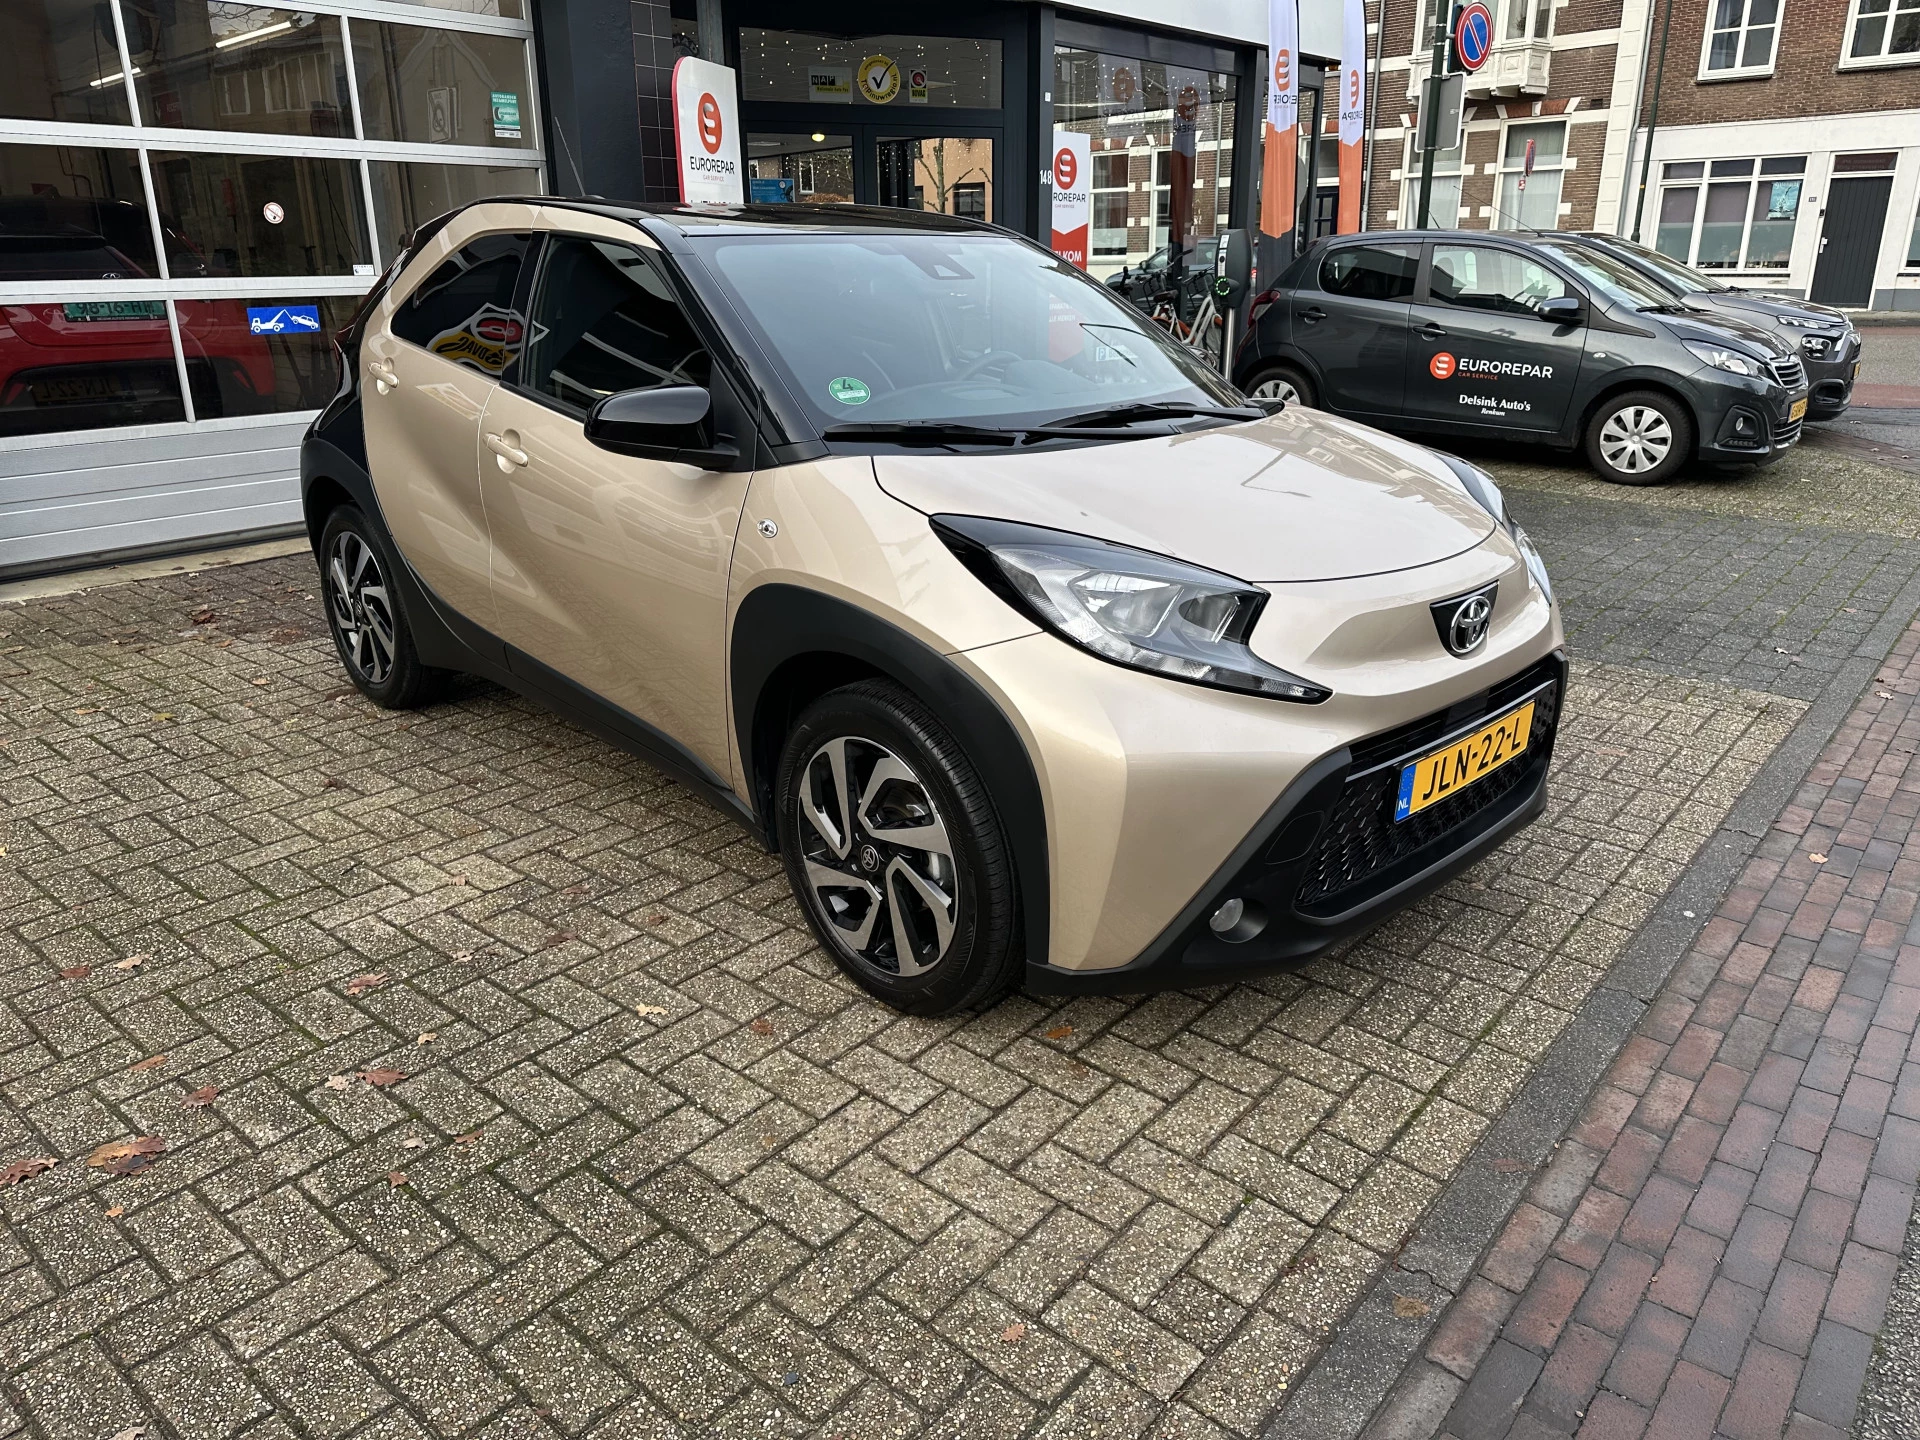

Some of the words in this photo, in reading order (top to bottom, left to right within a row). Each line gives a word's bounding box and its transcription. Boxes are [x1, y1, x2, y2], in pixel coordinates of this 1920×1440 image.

[811, 75, 835, 85] NAP
[911, 89, 926, 98] BOVAG
[689, 156, 735, 175] EUROREPAR
[1040, 169, 1053, 185] 148
[1053, 192, 1086, 203] ROREPAR
[1458, 357, 1554, 379] EUROREPAR
[1471, 372, 1499, 381] SERVICE
[842, 379, 854, 391] 4
[1459, 394, 1498, 408] Delsink
[1499, 398, 1531, 411] Auto's
[1480, 407, 1506, 416] Renkum
[1422, 716, 1521, 801] JLN-22-L
[1398, 797, 1409, 811] NL
